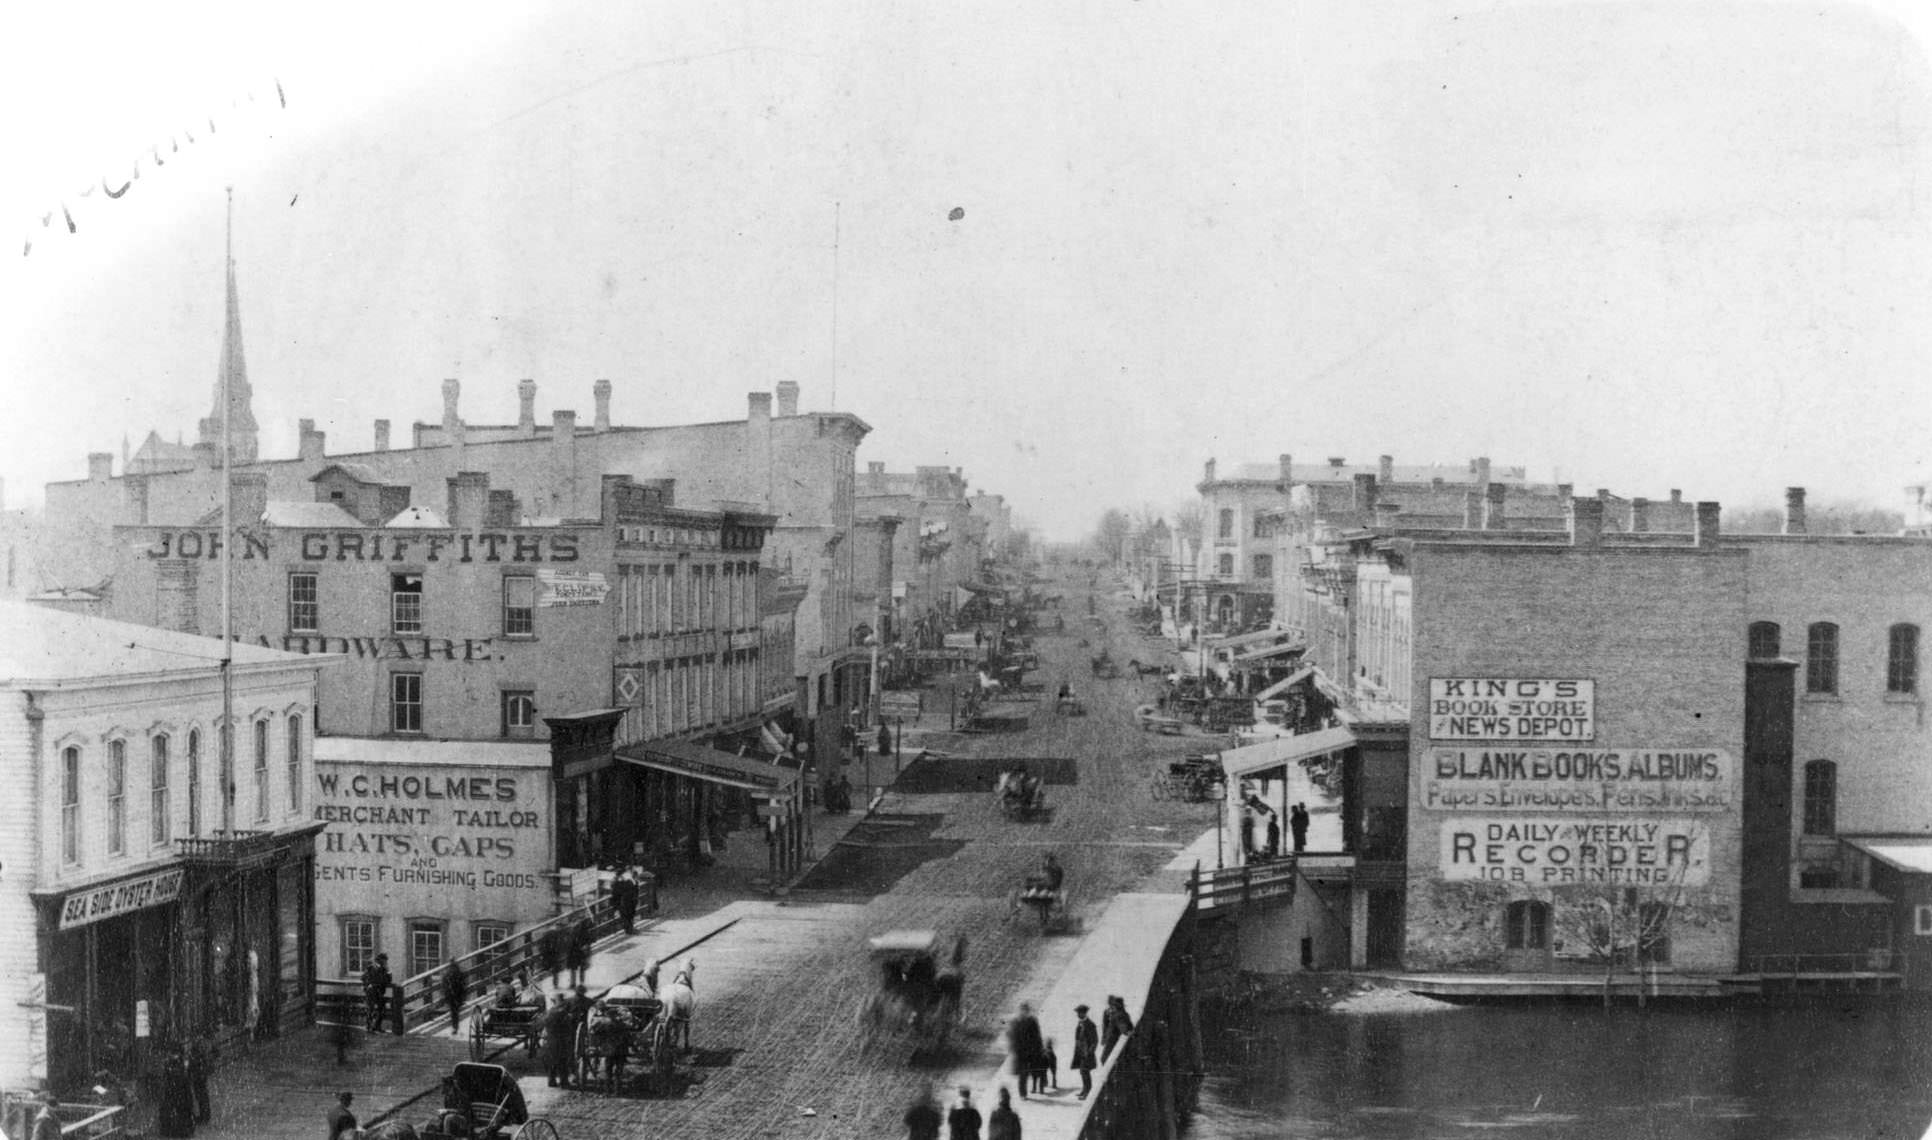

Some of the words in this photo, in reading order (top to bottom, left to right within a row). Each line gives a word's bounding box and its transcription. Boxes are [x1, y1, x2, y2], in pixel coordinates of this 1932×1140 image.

[147, 531, 270, 560] JOHN
[302, 533, 579, 562] GRIFFITHS
[216, 633, 505, 661] RDWARE.
[1445, 680, 1578, 697] KING'S
[1433, 699, 1499, 716] BOOK
[1508, 699, 1587, 717] STORE
[1450, 716, 1511, 736] NEWS
[1435, 752, 1528, 780] BLANK
[453, 810, 539, 828] TAILOR
[1487, 824, 1559, 841] DAILY
[1574, 824, 1659, 842] WEEKLY
[410, 858, 438, 868] AND
[378, 865, 477, 887] FURNISHING
[1542, 866, 1669, 882] PRINTING
[65, 897, 88, 922] SEA
